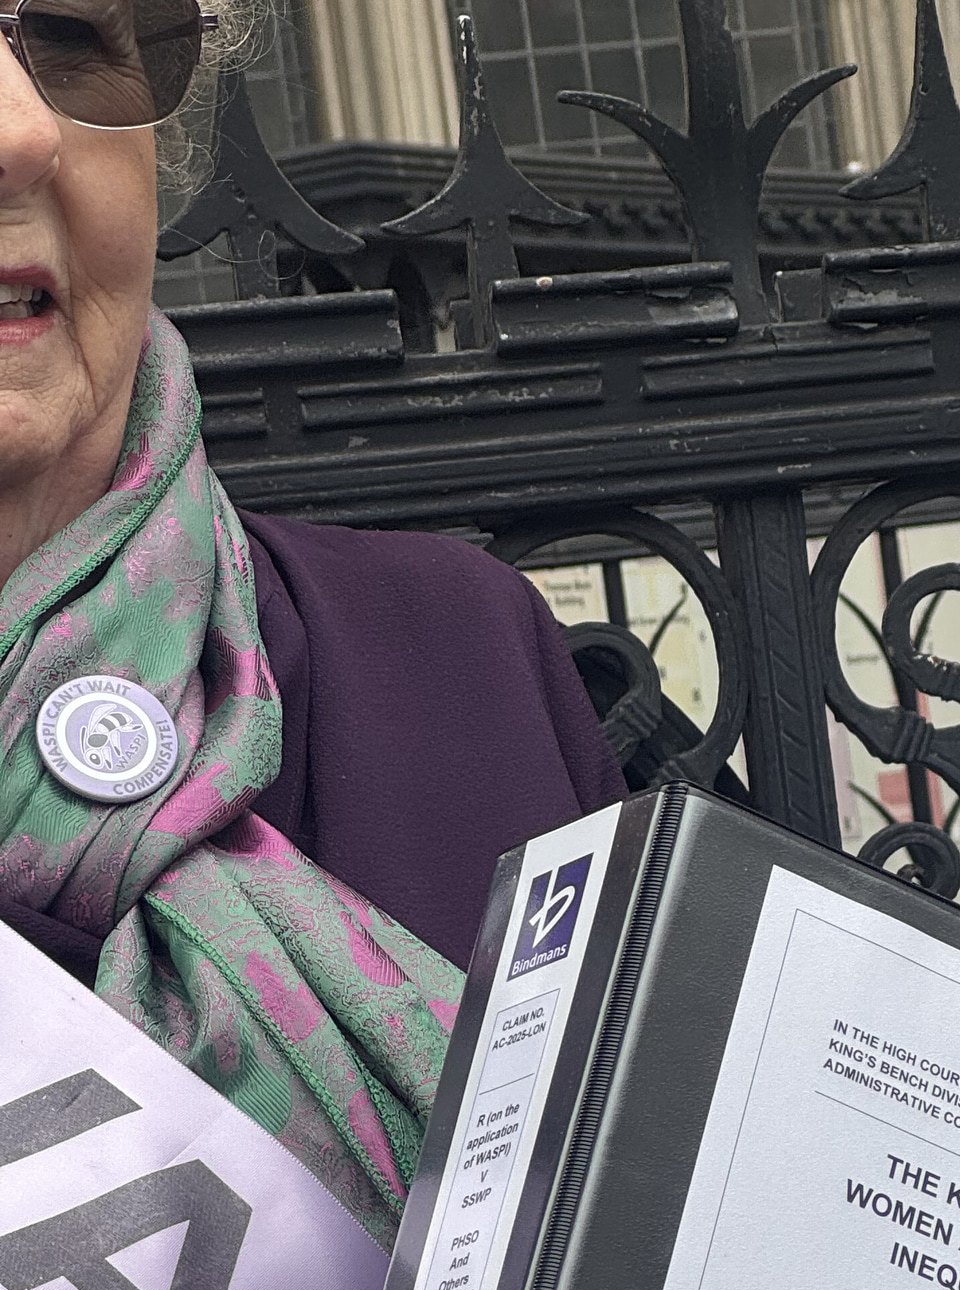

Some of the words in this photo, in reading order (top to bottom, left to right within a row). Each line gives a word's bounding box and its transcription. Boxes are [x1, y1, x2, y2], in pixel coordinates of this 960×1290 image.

[42, 722, 68, 773] WASPI
[86, 680, 131, 697] WAIT
[112, 719, 173, 795] COMPENSATE!
[115, 733, 147, 770] WASPI
[511, 943, 568, 976] Bindmans
[502, 1012, 530, 1031] CLAIM
[530, 1007, 545, 1021] NO.
[492, 1021, 547, 1052] AC-2025-LON
[833, 1019, 848, 1035] IN
[853, 1027, 879, 1049] THE
[882, 1041, 916, 1066] HIGH
[823, 1058, 941, 1119] ADMINISTRATIVE
[880, 1061, 928, 1092] BENCH
[477, 1114, 486, 1127] R
[487, 1110, 502, 1127] (on
[505, 1103, 520, 1117] the
[466, 1123, 519, 1151] application
[463, 1154, 475, 1170] of
[476, 1141, 512, 1166] WASPI)
[886, 1153, 941, 1199] THE
[461, 1187, 492, 1209] SSWP
[846, 1178, 954, 1246] WOMEN
[450, 1229, 480, 1251] PHSO
[449, 1252, 471, 1271] And
